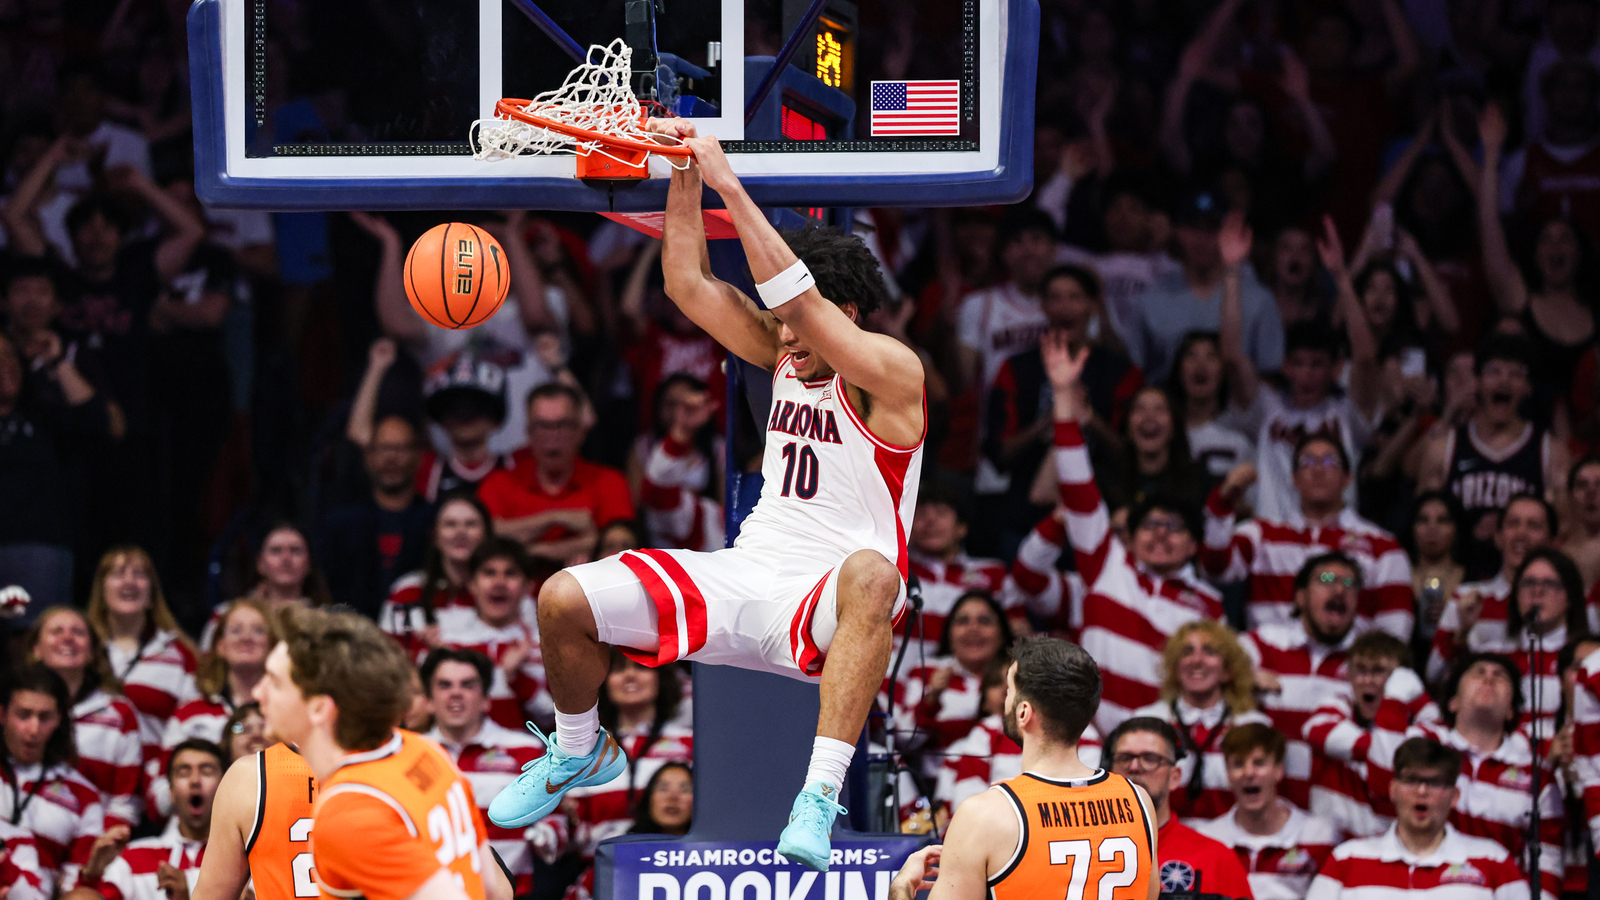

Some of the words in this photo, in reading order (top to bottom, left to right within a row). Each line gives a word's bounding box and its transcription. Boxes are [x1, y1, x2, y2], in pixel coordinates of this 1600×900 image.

[456, 239, 474, 295] ELITE
[768, 400, 843, 445] ARIONA
[780, 442, 819, 500] 10
[1037, 797, 1135, 828] MANTZOUKAS
[1048, 836, 1138, 900] 72
